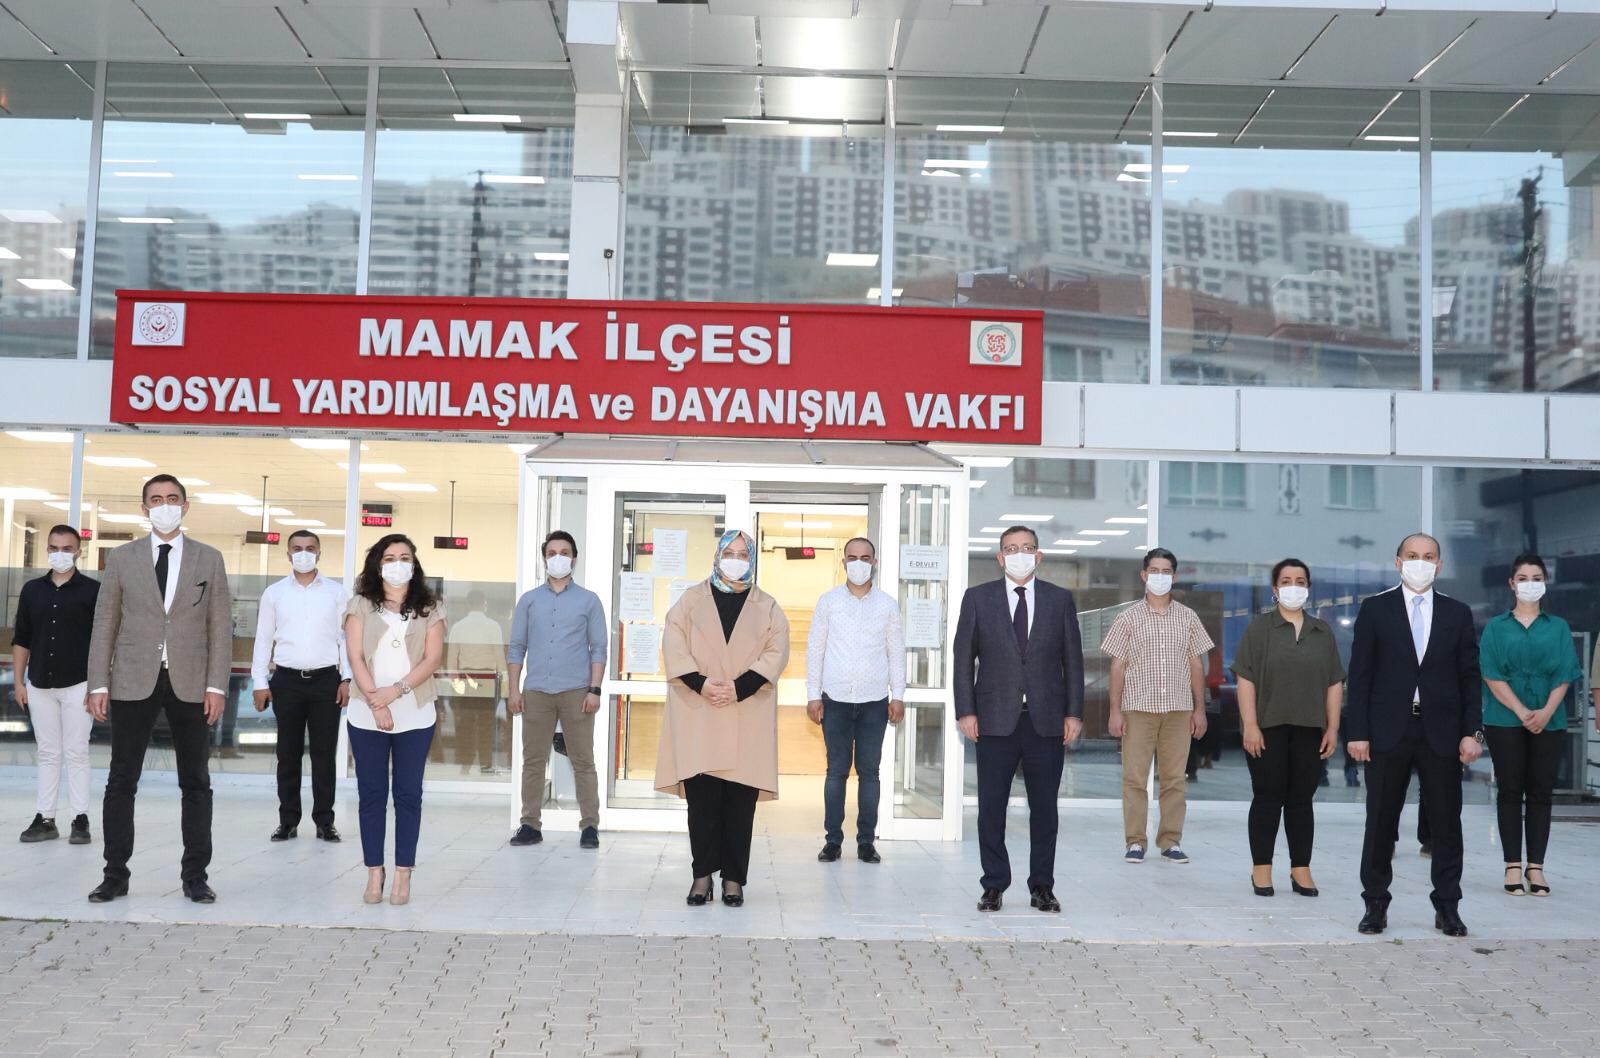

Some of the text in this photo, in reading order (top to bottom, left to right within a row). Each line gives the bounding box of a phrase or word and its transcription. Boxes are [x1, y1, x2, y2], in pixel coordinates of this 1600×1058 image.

[359, 311, 792, 372] MAMAK İLÇESİ
[128, 375, 1025, 433] SOSYAL YARDIMLAŞMA ve DAYANIŞMA VAKFI
